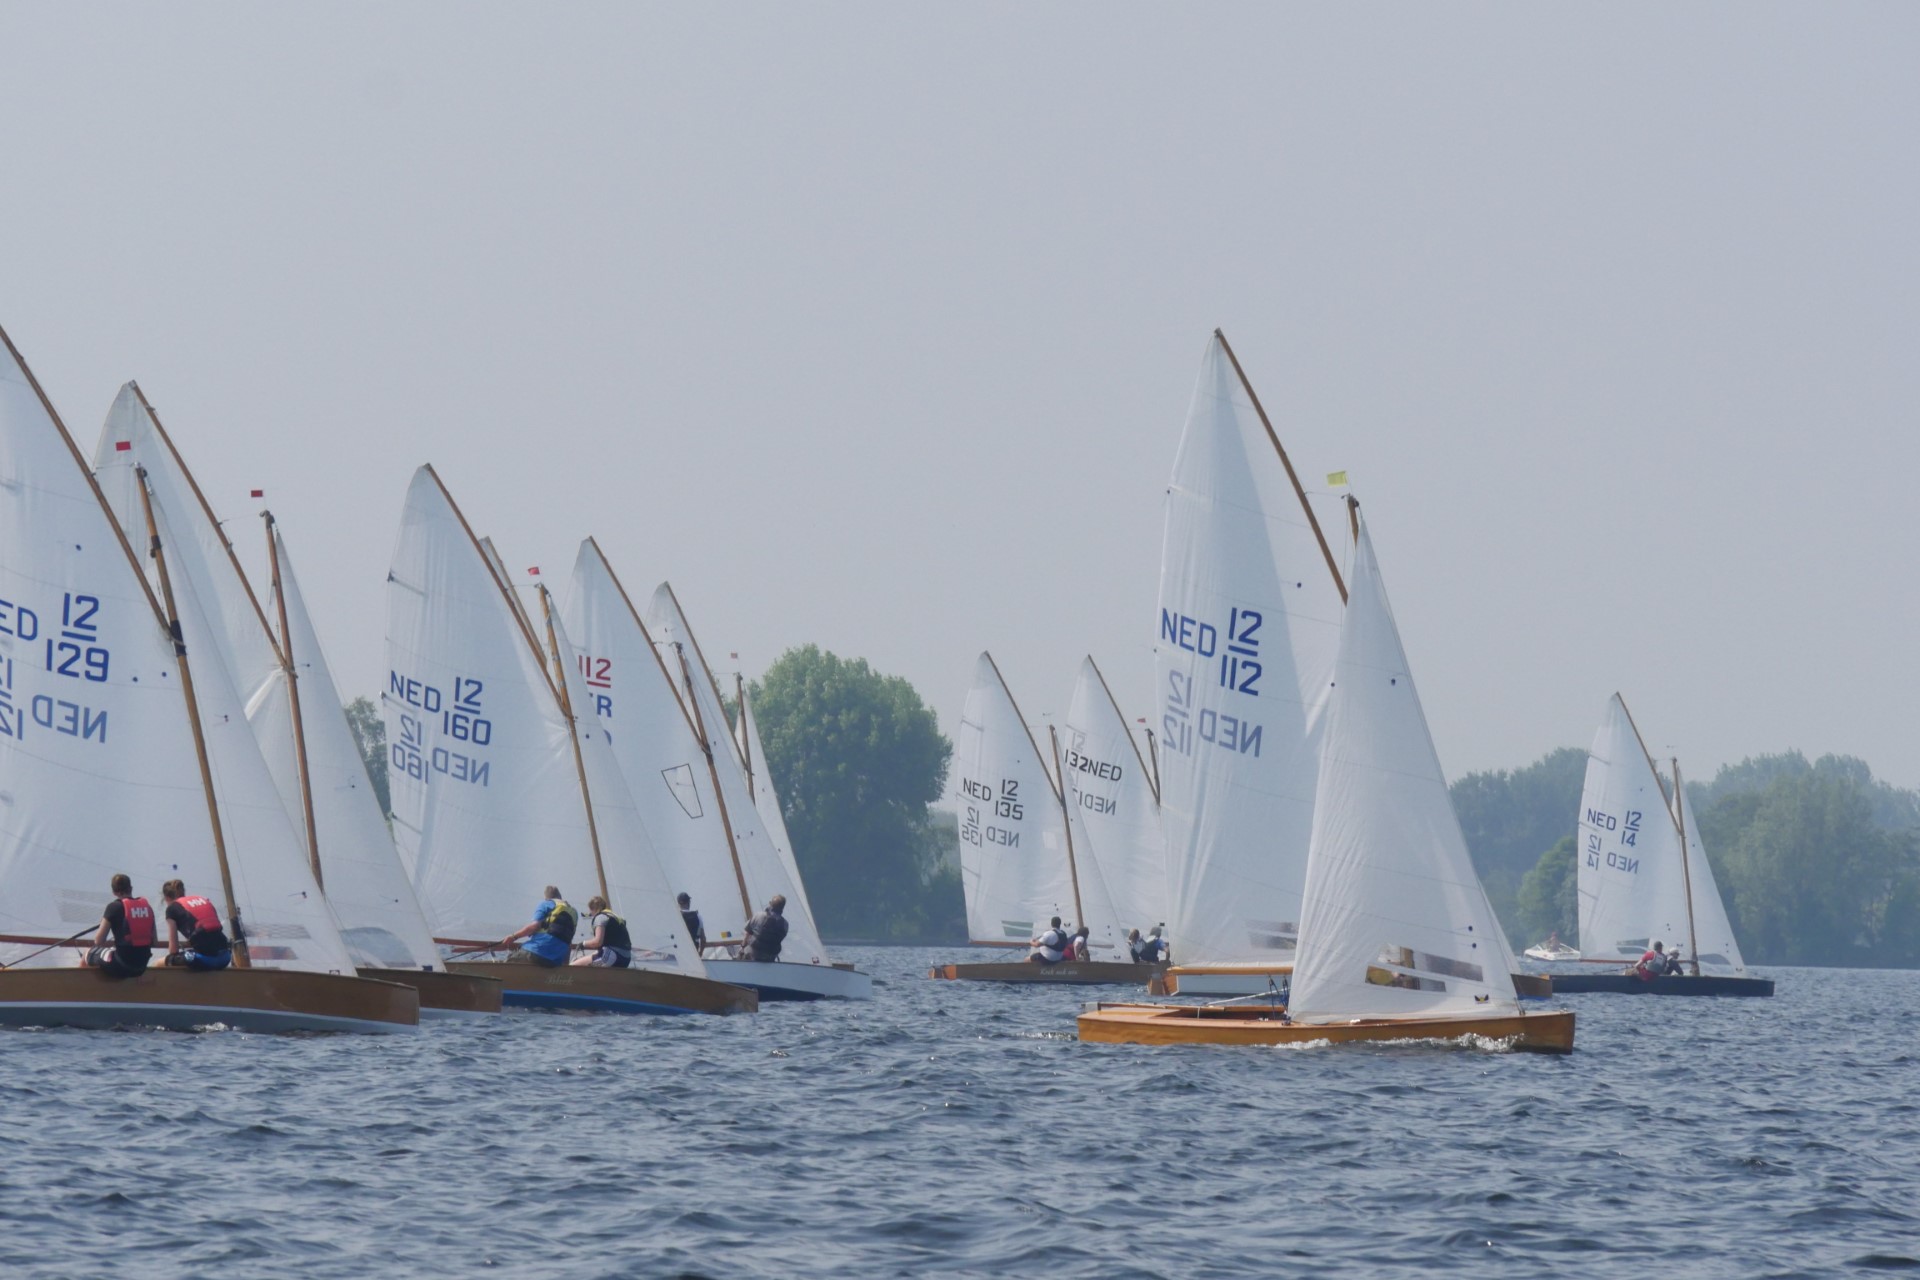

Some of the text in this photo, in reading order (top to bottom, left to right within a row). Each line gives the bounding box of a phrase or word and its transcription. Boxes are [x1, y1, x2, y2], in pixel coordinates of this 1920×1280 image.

[63, 592, 99, 631] 12
[1161, 607, 1217, 658] NED
[1228, 607, 1262, 646] 12
[46, 638, 109, 682] 129
[1220, 654, 1262, 696] 112
[390, 670, 441, 714] NED
[454, 676, 483, 706] 12
[443, 711, 492, 746] 160
[963, 777, 991, 801] NED
[1001, 779, 1018, 796] 12
[995, 801, 1023, 820] 135
[1587, 808, 1617, 831] NED
[1625, 810, 1642, 827] 12
[1621, 830, 1636, 847] 14
[131, 907, 149, 918] HH
[187, 897, 206, 908] HH
